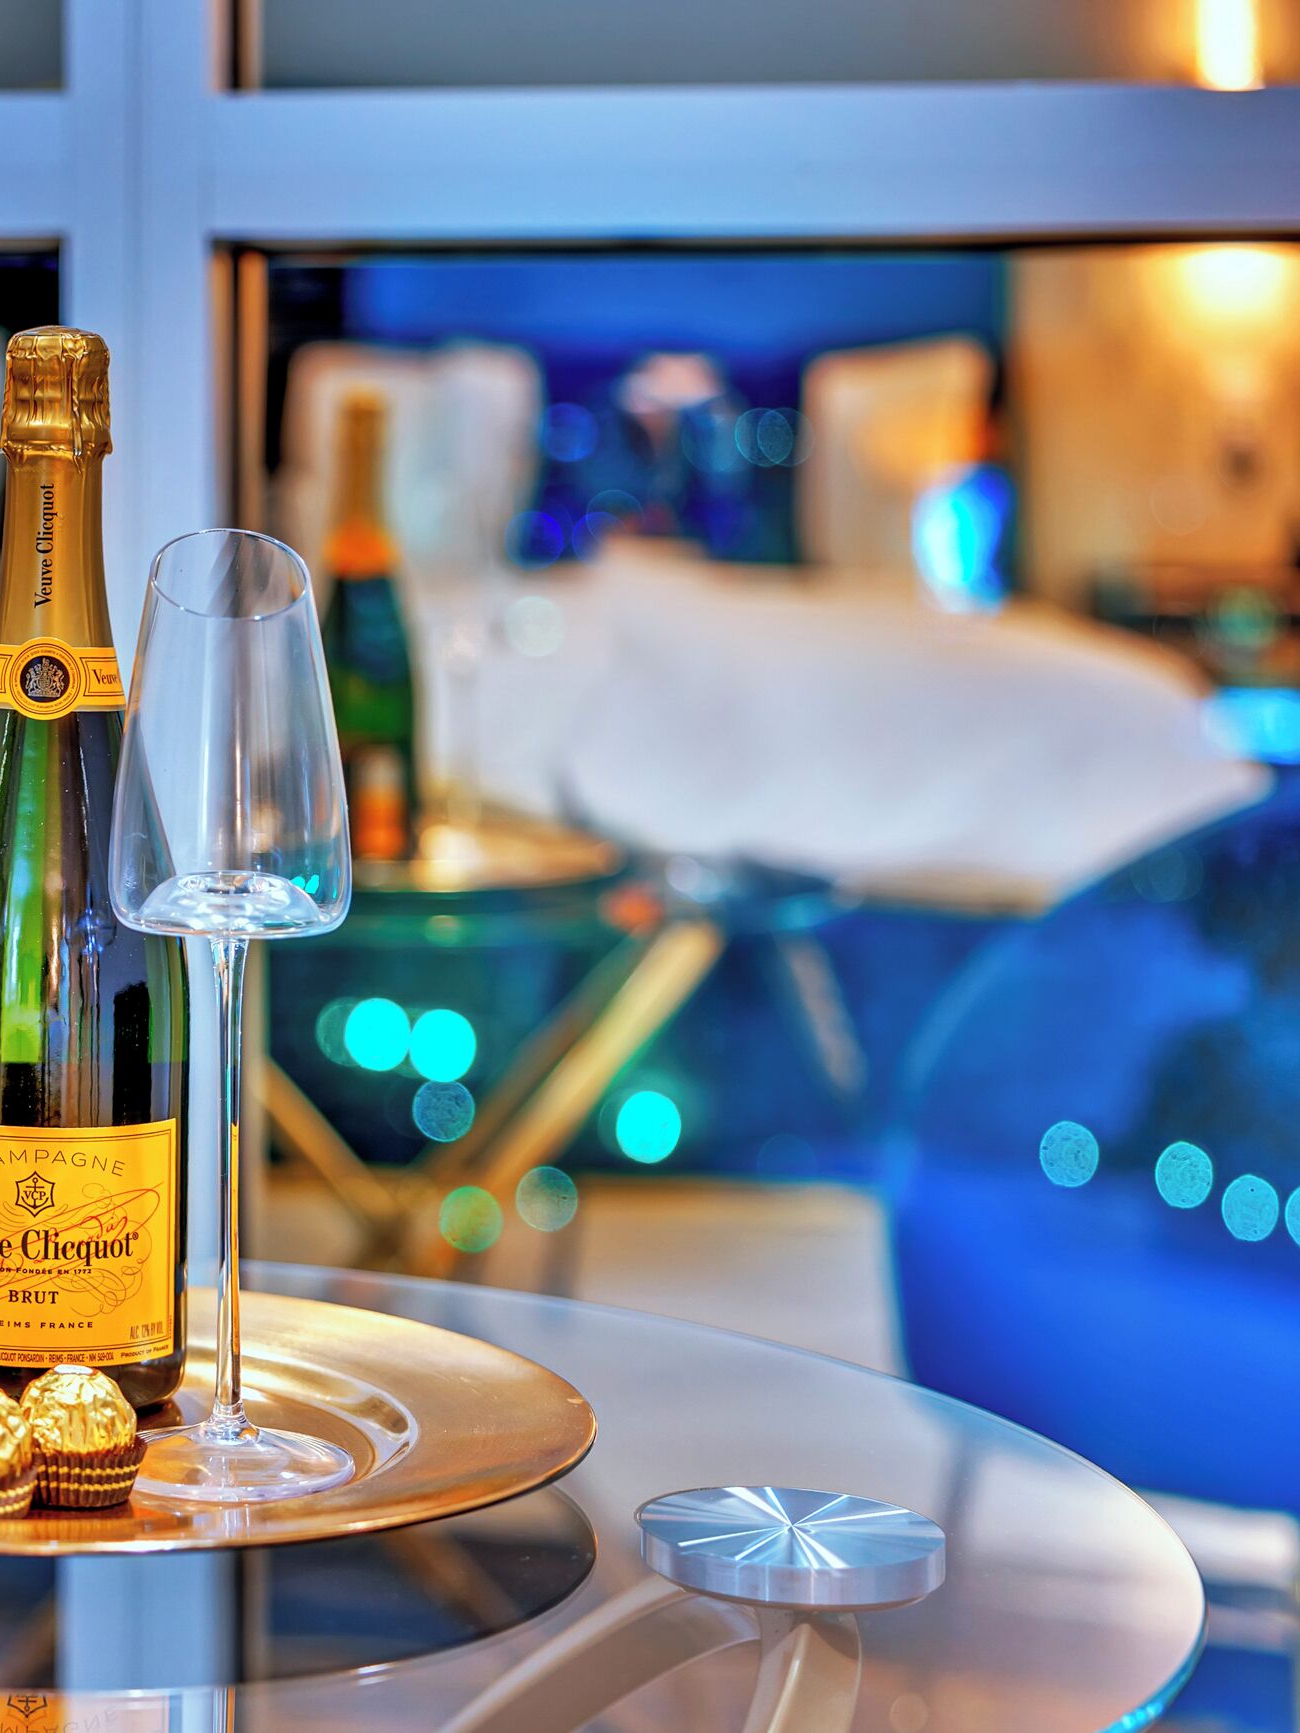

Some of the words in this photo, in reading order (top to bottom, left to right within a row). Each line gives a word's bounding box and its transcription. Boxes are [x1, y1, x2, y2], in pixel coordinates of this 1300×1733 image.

[36, 483, 58, 554] Clicquot
[34, 557, 52, 608] Veuve
[23, 1190, 47, 1201] VCP
[7, 1289, 59, 1305] BRUT
[40, 1321, 94, 1329] FRANCE
[67, 1353, 85, 1363] FRANCE
